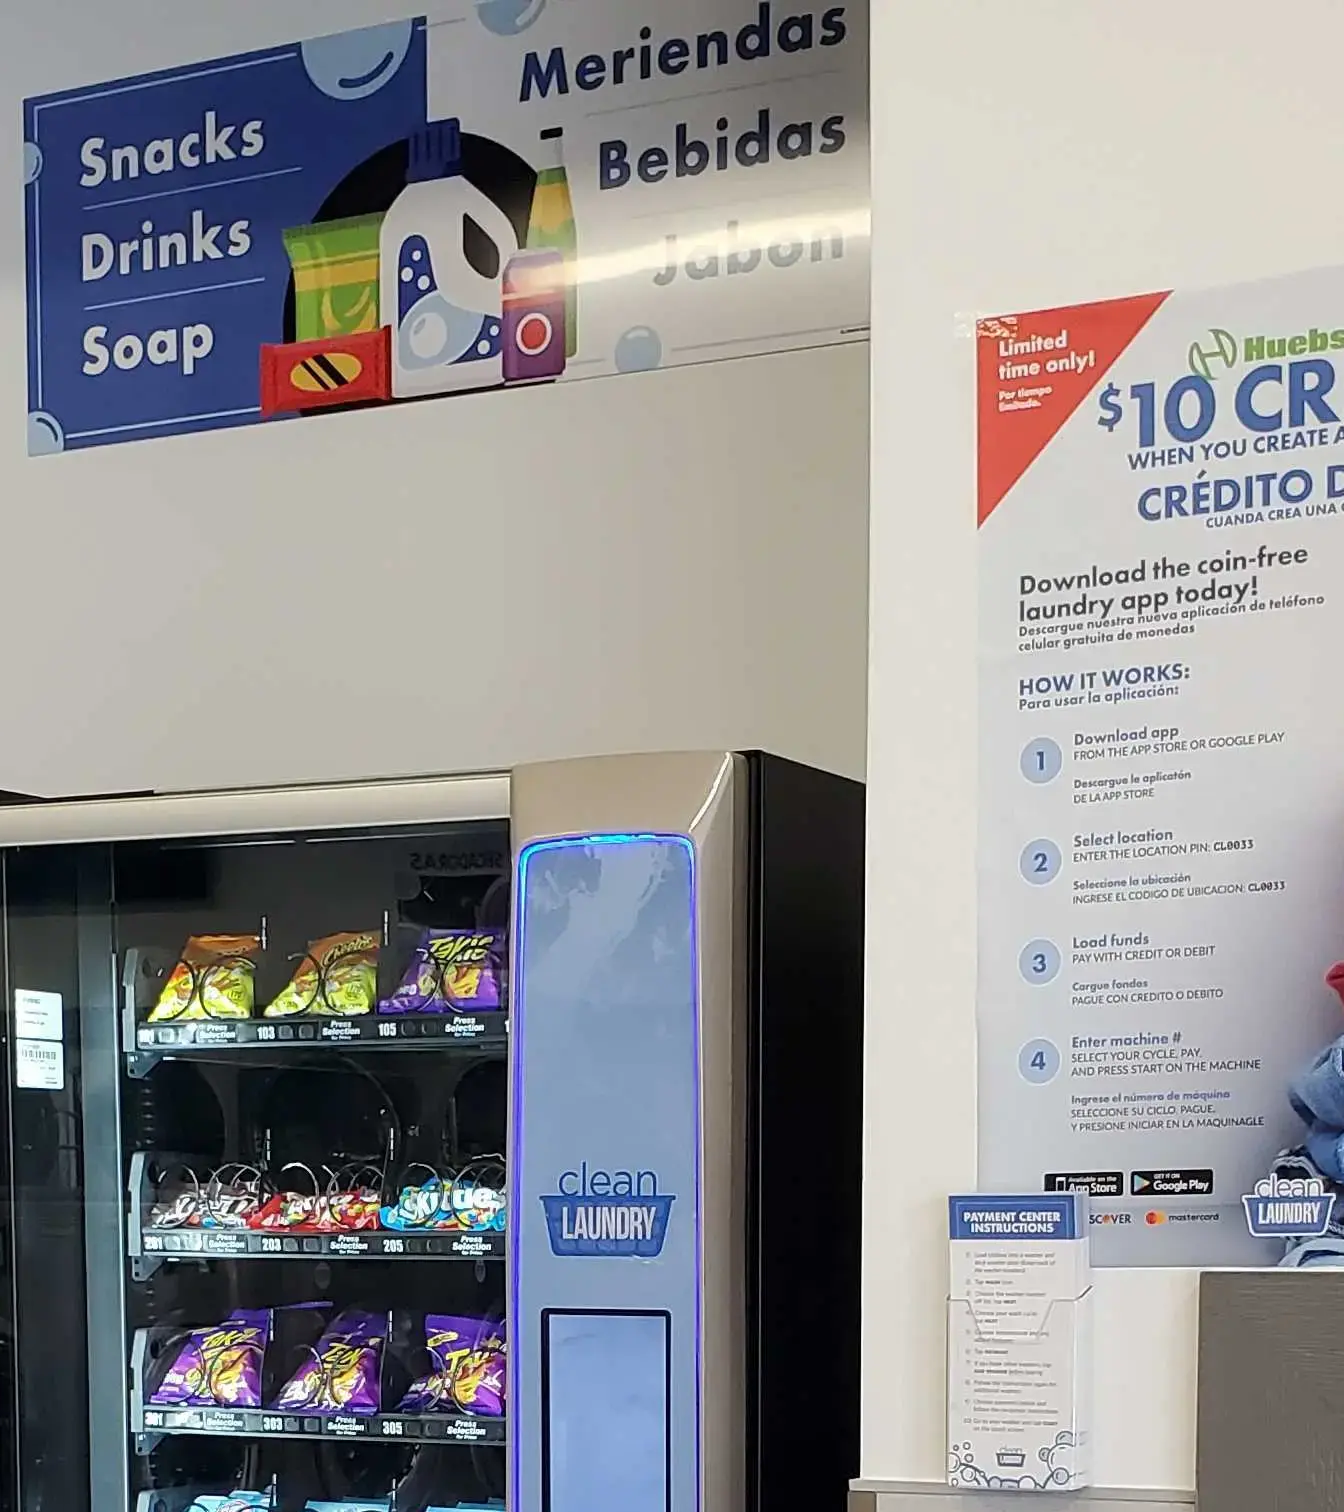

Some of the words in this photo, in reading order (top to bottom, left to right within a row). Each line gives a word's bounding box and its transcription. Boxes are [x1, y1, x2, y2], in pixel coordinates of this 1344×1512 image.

[519, 1, 846, 102] Meriendas
[78, 110, 265, 187] Snacks
[599, 108, 846, 190] Bebidas
[81, 210, 253, 282] Drinks
[83, 319, 216, 375] Soap
[998, 329, 1068, 357] Limited
[998, 359, 1040, 381] time
[1045, 350, 1096, 375] only!
[1097, 375, 1216, 449] $10
[1128, 446, 1194, 471] WHEN
[1201, 439, 1247, 461] YOU
[1253, 428, 1329, 454] CREATE
[1137, 468, 1314, 522] CRÉDITO
[1206, 512, 1265, 528] CUANDA
[1267, 508, 1302, 522] CREA
[1305, 502, 1337, 517] UNA
[1020, 559, 1146, 595] Download
[1152, 557, 1191, 580] the
[1197, 544, 1309, 576] coin-free
[1020, 593, 1114, 624] laundry
[1121, 589, 1168, 617] app
[1175, 576, 1259, 605] today!
[1019, 620, 1084, 637] Descargue
[1087, 614, 1135, 630] nuestra
[1137, 609, 1178, 623] nueva
[1180, 602, 1246, 620] aplicación
[1249, 600, 1266, 612] de
[1269, 594, 1325, 609] teléfono
[1018, 637, 1060, 652] celular
[1063, 632, 1114, 649] gratuita
[1117, 629, 1133, 641] de
[1135, 623, 1196, 639] monedas
[1019, 674, 1074, 696] HOW
[1080, 672, 1097, 690] IT
[1102, 663, 1191, 688] WORKS:
[1019, 697, 1051, 710] Para
[1054, 693, 1085, 707] usar
[1088, 691, 1101, 703] la
[1104, 684, 1179, 703] aplicación:
[1074, 730, 1147, 747] Download
[1151, 726, 1179, 741] app
[1036, 751, 1045, 770] 1
[1074, 833, 1113, 847] Select
[1117, 828, 1173, 844] location
[1033, 852, 1048, 872] 2
[1073, 851, 1106, 863] ENTER
[1110, 849, 1130, 860] THE
[1133, 844, 1187, 858] LOCATION
[1189, 842, 1211, 853] PIN:
[1213, 839, 1254, 852] CL0033
[1072, 935, 1106, 949] Load
[1111, 932, 1149, 946] funds
[1032, 954, 1047, 974] 3
[378, 1023, 397, 1037] 105
[444, 1023, 484, 1034] Selection
[453, 1016, 476, 1026] Press
[1072, 1035, 1106, 1049] Enter
[1110, 1033, 1169, 1047] machine
[1172, 1032, 1181, 1044] #
[1031, 1051, 1046, 1070] 4
[559, 1161, 656, 1196] clean
[1090, 1182, 1117, 1194] Store
[1154, 1180, 1188, 1192] Google
[1190, 1179, 1209, 1192] Play
[1255, 1173, 1324, 1197] clean
[562, 1207, 656, 1240] LAUNDRY
[964, 1212, 1017, 1222] PAYMENT
[1019, 1212, 1060, 1222] CENTER
[1168, 1212, 1219, 1222] mastercard
[1258, 1203, 1320, 1224] LAUNDRY
[971, 1223, 1054, 1233] INSTRUCTIONS
[383, 1238, 403, 1252] 205
[383, 1422, 402, 1435] 305
